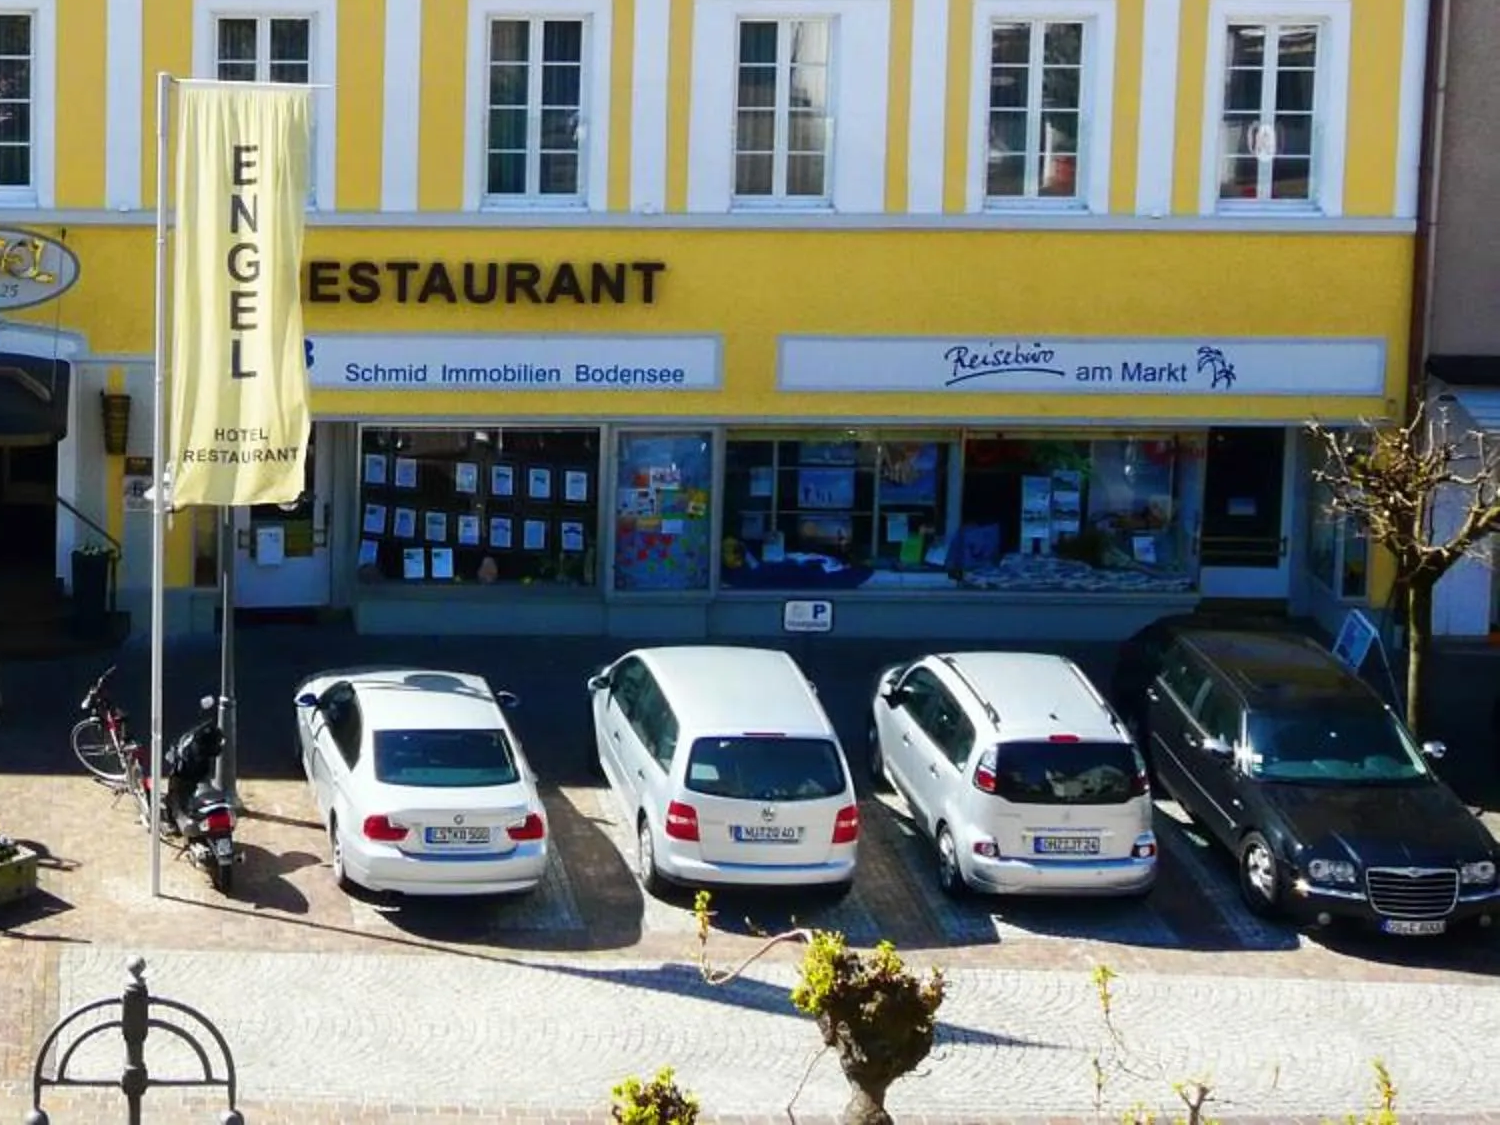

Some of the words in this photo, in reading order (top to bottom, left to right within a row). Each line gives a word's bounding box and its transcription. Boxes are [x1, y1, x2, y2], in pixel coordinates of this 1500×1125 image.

[227, 143, 261, 380] ENGEL
[305, 261, 666, 305] ESTAURANT
[943, 341, 1055, 376] Reisebüro
[1075, 365, 1113, 383] am
[1121, 361, 1188, 383] Markt
[345, 363, 428, 383] Schmid
[441, 363, 561, 383] Immobilien
[575, 363, 686, 384] Bodensee
[214, 427, 269, 442] HOTEL
[182, 446, 299, 464] RESTAURANT
[812, 603, 828, 620] P
